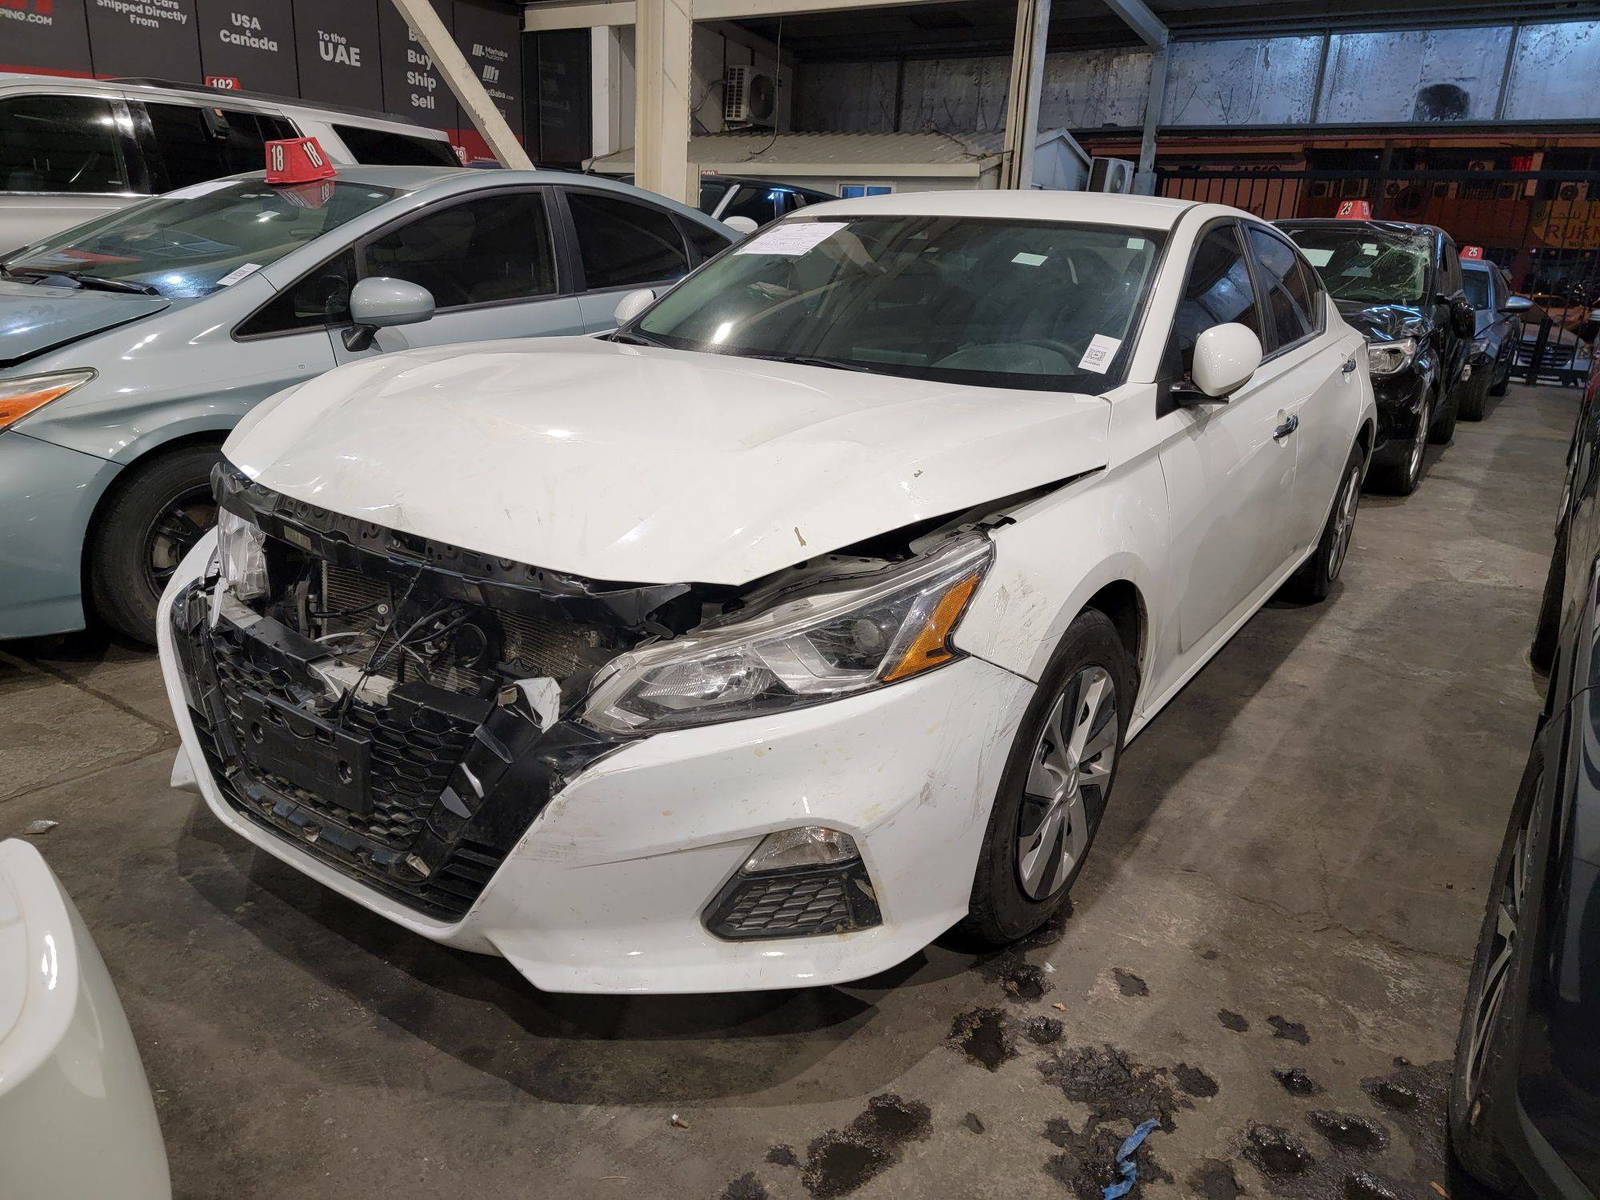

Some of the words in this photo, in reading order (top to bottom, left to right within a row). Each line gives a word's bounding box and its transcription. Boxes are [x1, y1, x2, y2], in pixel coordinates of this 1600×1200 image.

[97, 0, 143, 13] Shipped
[145, 6, 187, 24] Directly
[130, 14, 159, 28] From
[231, 13, 261, 30] USA
[219, 29, 278, 52] Canada
[317, 30, 330, 41] To
[331, 32, 347, 44] the
[319, 41, 361, 67] UAE
[407, 49, 433, 71] Buy
[407, 71, 437, 92] Ship
[411, 93, 435, 109] Sell
[271, 145, 284, 171] 18
[303, 141, 323, 168] 18
[1340, 201, 1353, 216] 23
[1468, 247, 1478, 257] 25
